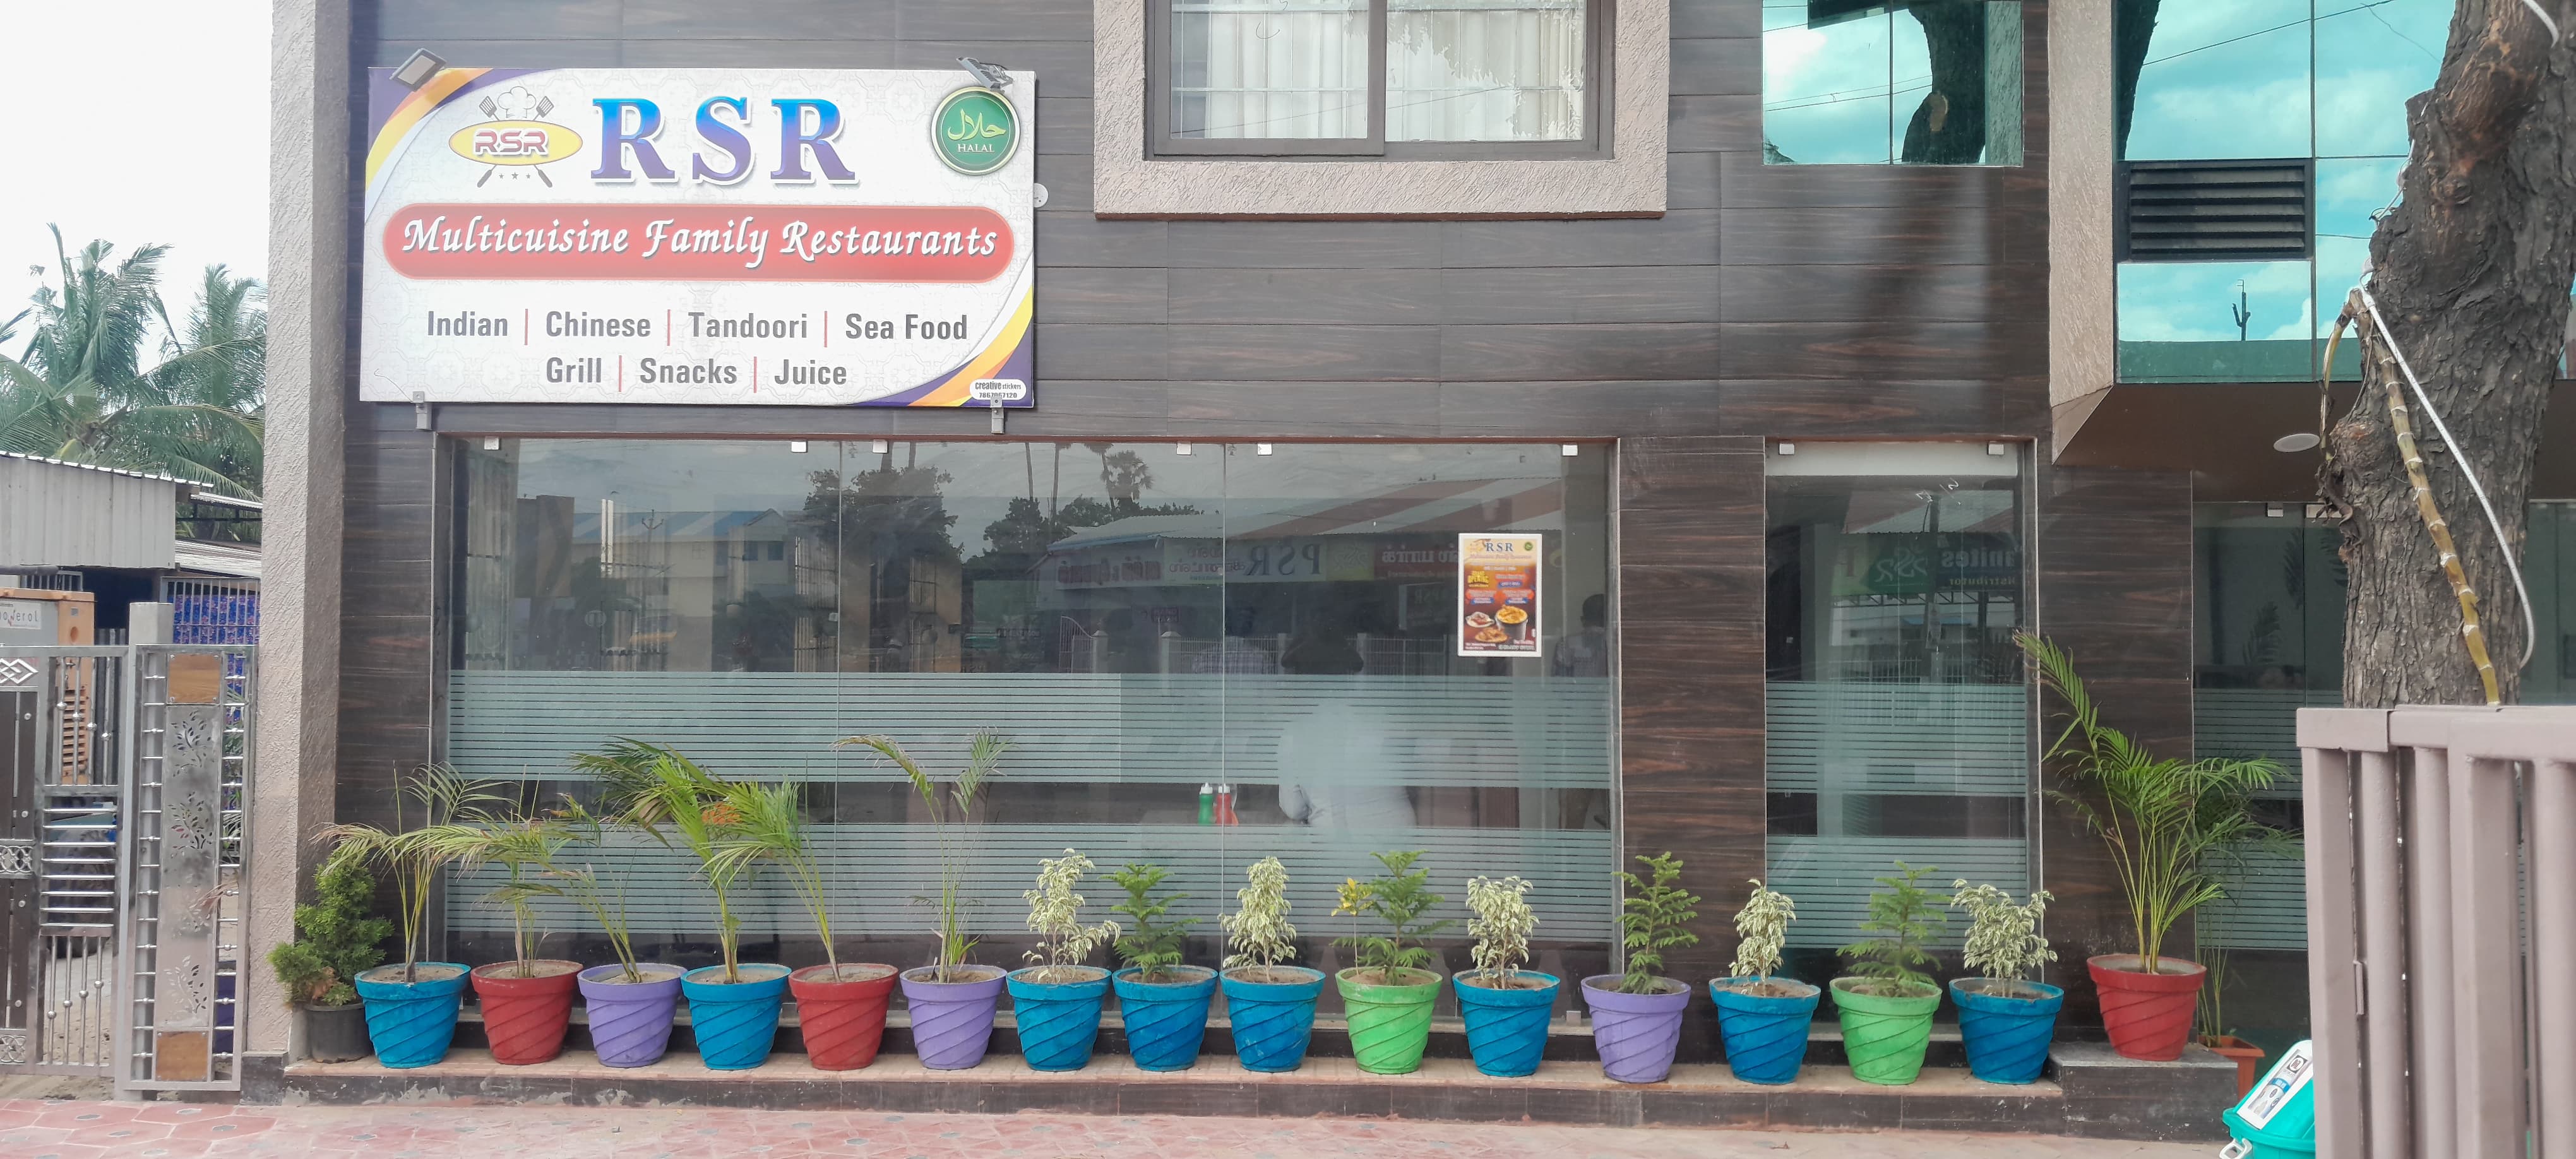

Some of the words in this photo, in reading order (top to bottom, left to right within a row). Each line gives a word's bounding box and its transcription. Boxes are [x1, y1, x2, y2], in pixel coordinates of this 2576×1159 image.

[591, 96, 857, 182] RSR
[948, 109, 1006, 140] حلال
[475, 130, 547, 153] RSR
[957, 143, 994, 153] HALAL
[402, 215, 628, 253] Multicuisine
[641, 216, 768, 269] Family
[780, 220, 998, 262] Restaurants
[427, 311, 508, 336] Indian
[546, 311, 651, 337] Chinese
[688, 312, 808, 338] Tandoori
[845, 313, 894, 340] Sea
[905, 314, 967, 340] Food
[546, 357, 602, 384] Grill
[640, 357, 737, 384] Snacks
[774, 359, 847, 386] Juice
[975, 381, 1002, 389] creative
[1486, 542, 1514, 552] RSR
